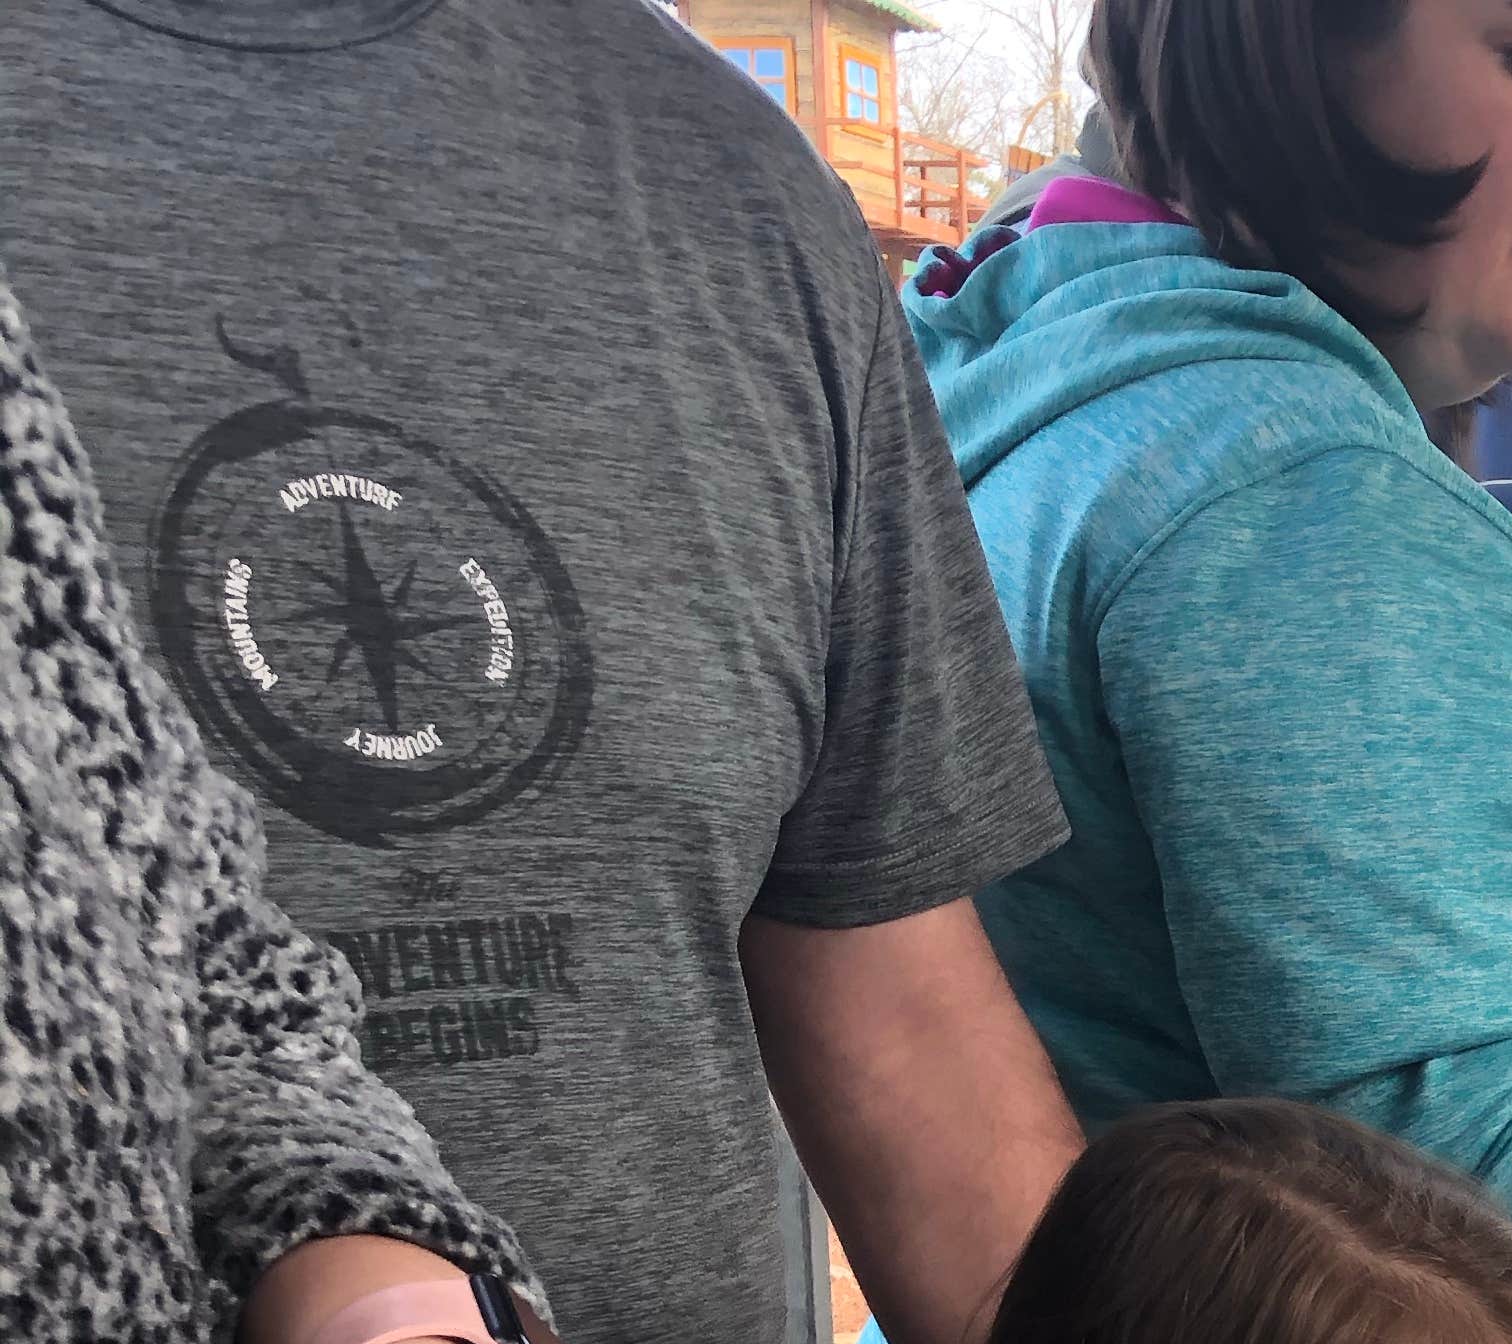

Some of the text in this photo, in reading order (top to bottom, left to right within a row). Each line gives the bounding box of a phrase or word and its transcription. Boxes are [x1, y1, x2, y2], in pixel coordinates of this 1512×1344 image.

[278, 473, 403, 513] ADVENTURE
[223, 558, 279, 691] MOUNTAINS
[459, 557, 514, 689] EXPEDITION
[343, 723, 443, 761] JOURNEY
